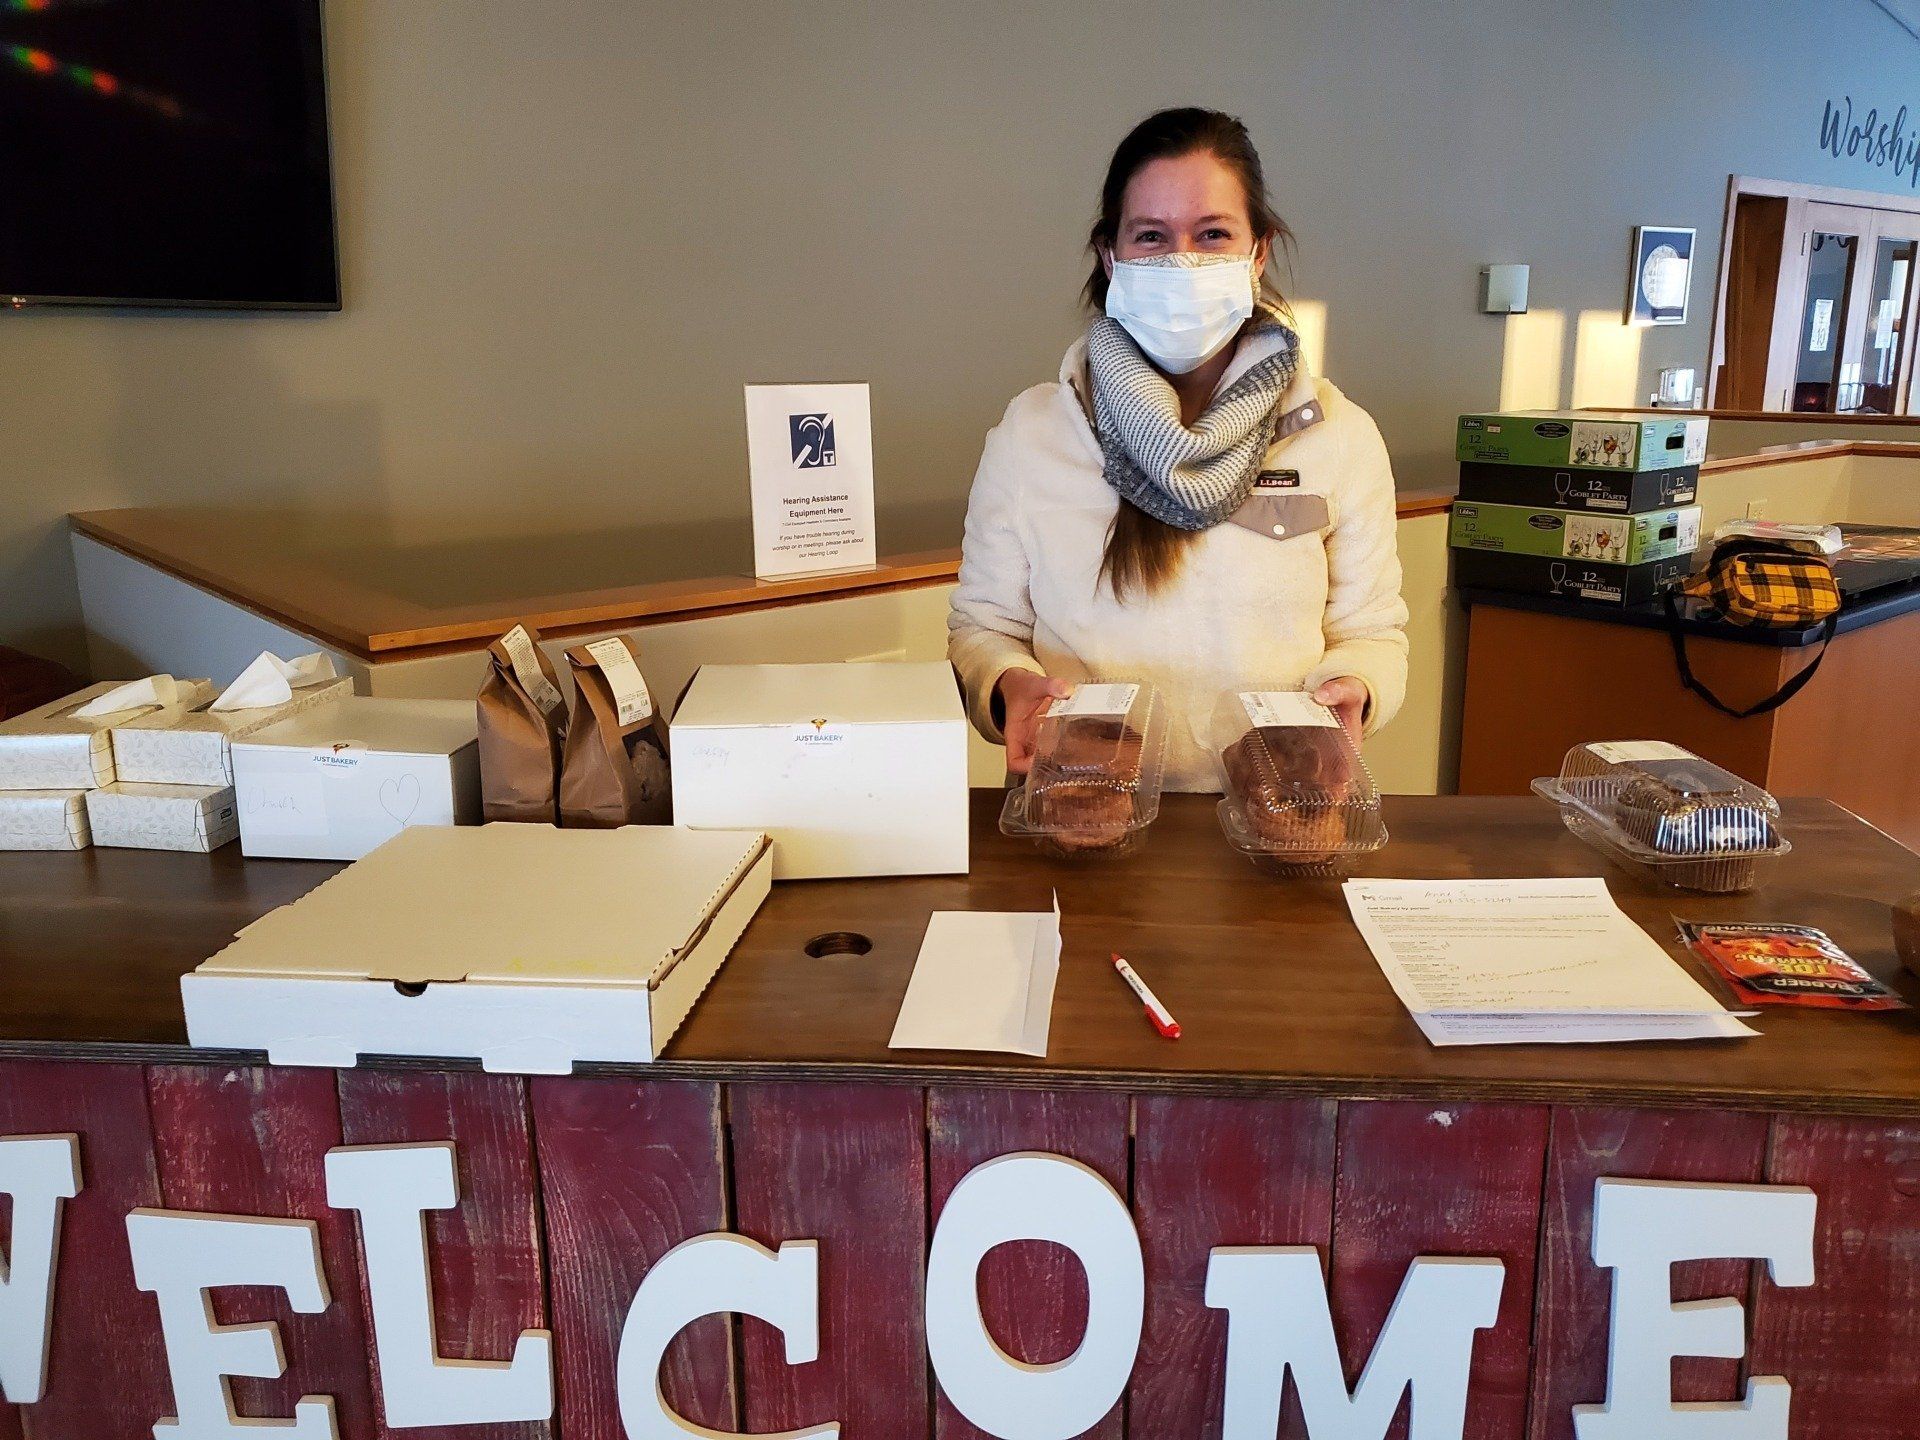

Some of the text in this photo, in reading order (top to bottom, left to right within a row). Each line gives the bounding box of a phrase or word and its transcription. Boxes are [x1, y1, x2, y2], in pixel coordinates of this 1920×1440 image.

[1469, 434, 1481, 444] 12
[1587, 480, 1602, 491] 12
[1676, 477, 1684, 487] 12
[783, 494, 849, 505] Hearing Assistance
[1569, 489, 1628, 501] GOBLET PARTY
[789, 507, 844, 518] Equipment Here
[1459, 508, 1475, 516] Libbey
[1465, 523, 1476, 532] 12
[1639, 535, 1647, 545] 12
[1669, 566, 1678, 575] 12
[1582, 571, 1597, 582] 12
[1564, 580, 1595, 590] GOBLET
[1597, 582, 1622, 593] PARTY
[1779, 963, 1830, 975] TOE
